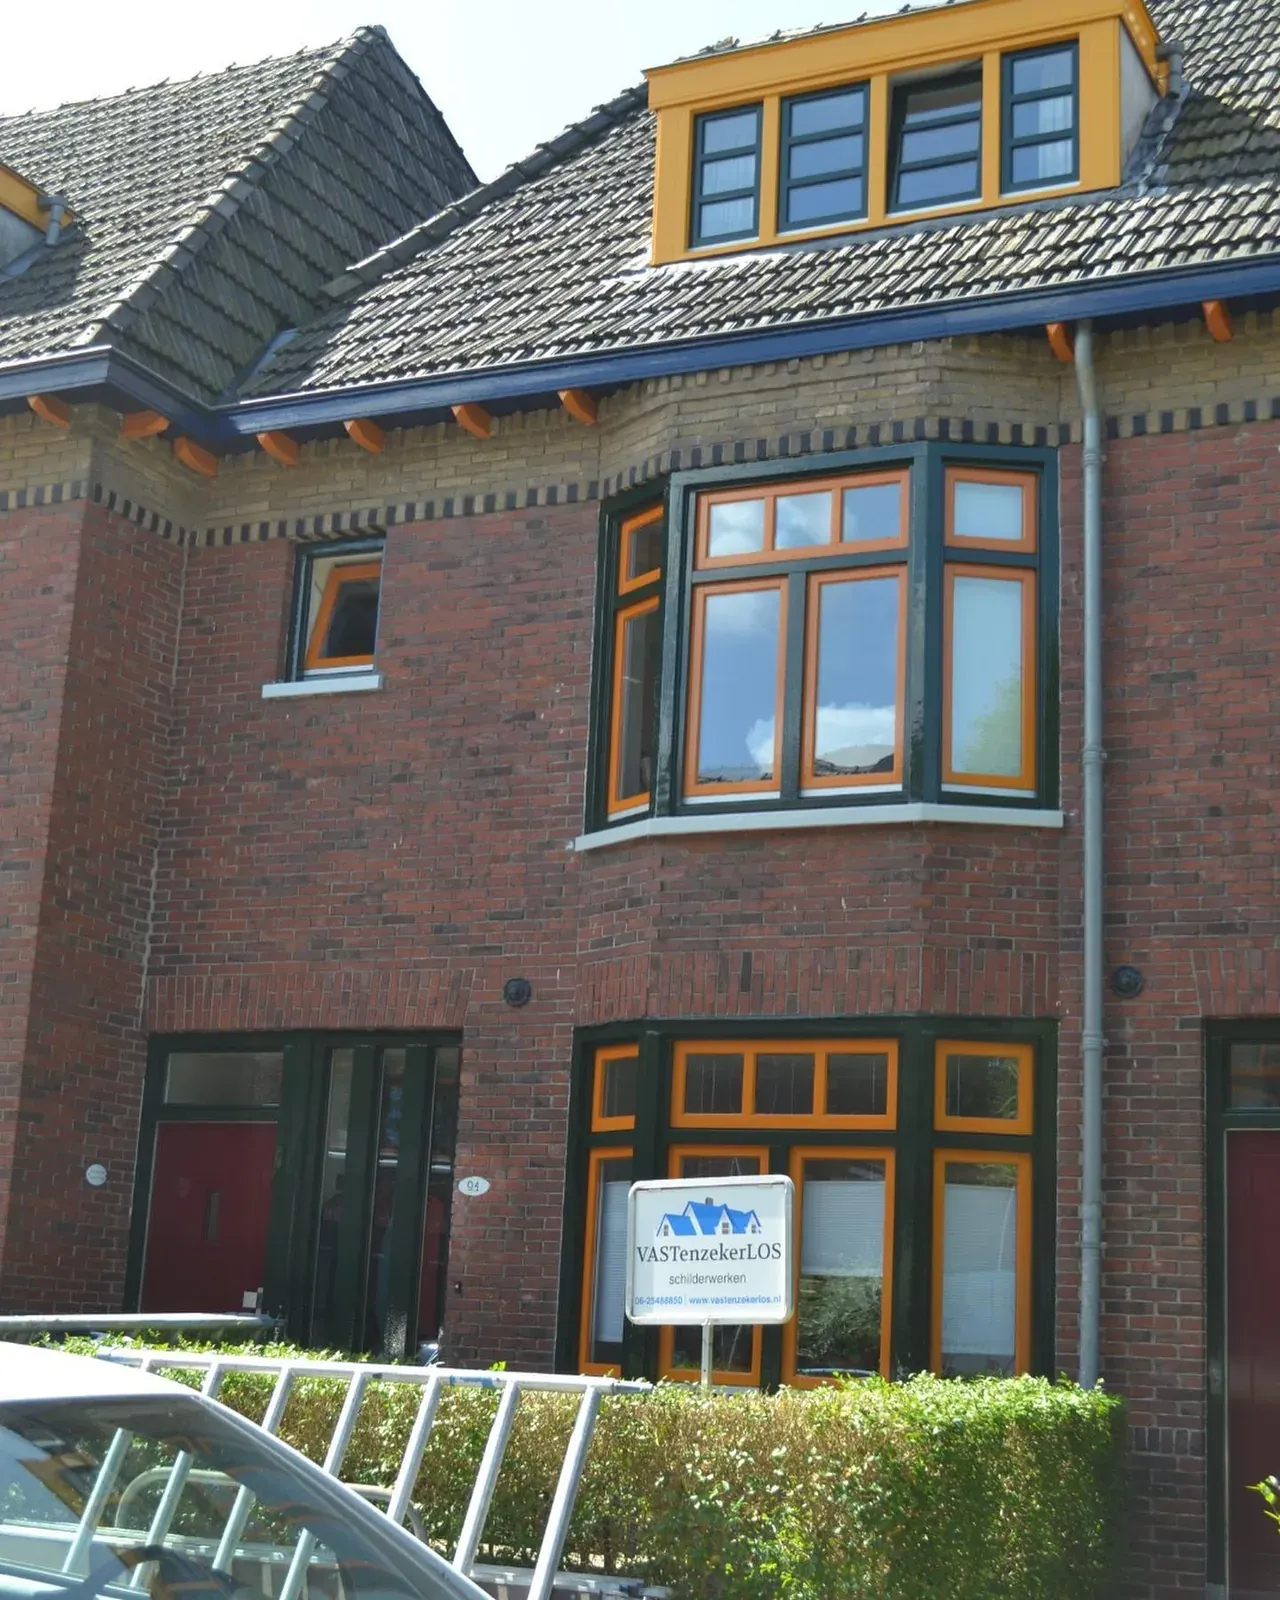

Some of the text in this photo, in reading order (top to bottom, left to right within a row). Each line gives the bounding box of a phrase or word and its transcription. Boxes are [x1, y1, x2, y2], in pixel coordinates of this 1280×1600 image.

[637, 1243, 781, 1262] VASTenzekerLOS
[669, 1273, 746, 1285] schilderwerken
[689, 1294, 781, 1305] www.vastenzekerlos.nl
